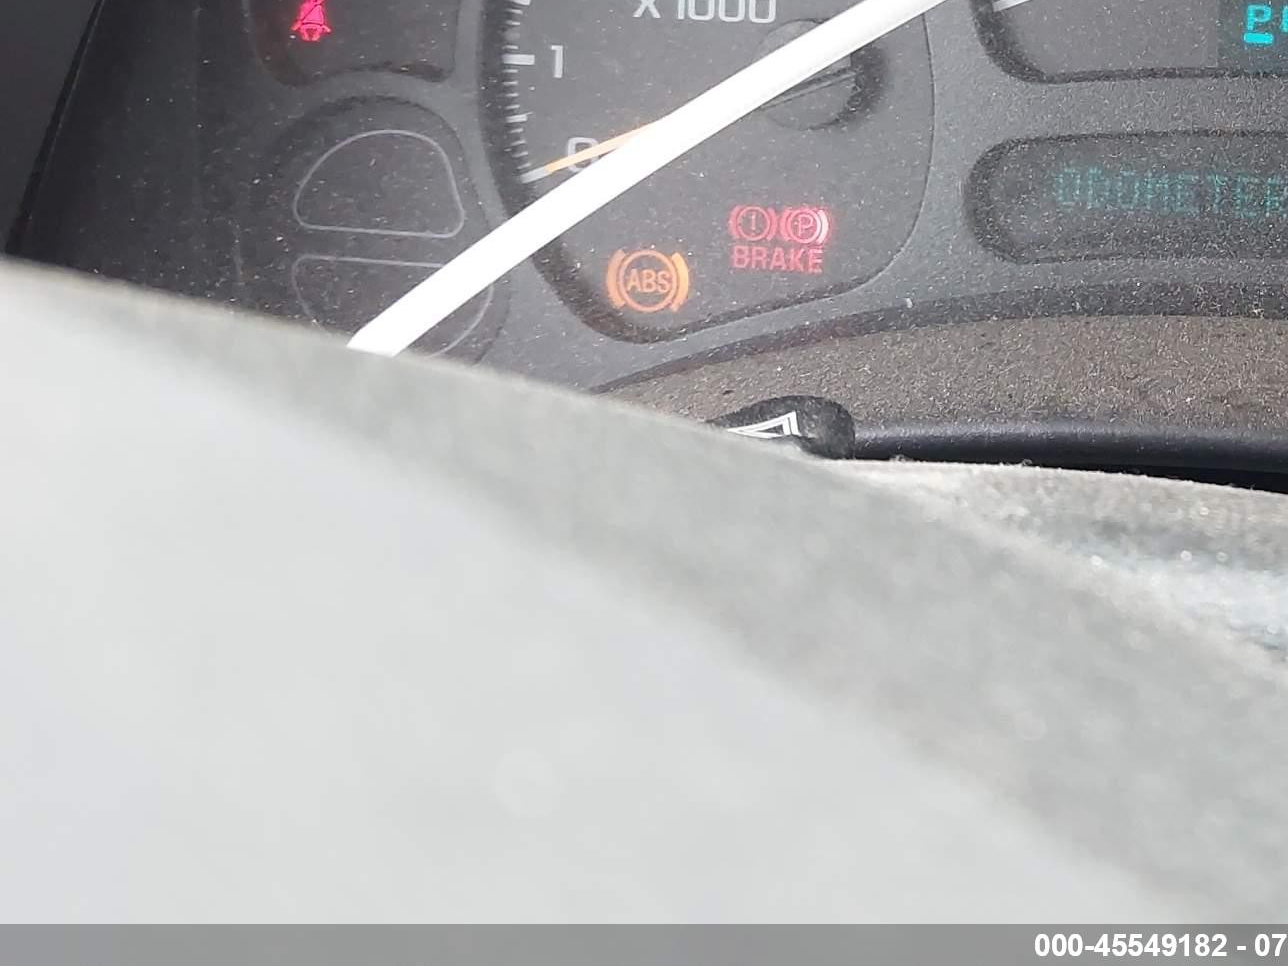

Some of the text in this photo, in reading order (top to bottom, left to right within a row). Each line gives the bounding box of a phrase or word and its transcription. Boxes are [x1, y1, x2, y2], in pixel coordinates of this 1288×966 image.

[550, 44, 564, 79] 1
[733, 245, 823, 273] BRAKE
[626, 270, 672, 294] ABS
